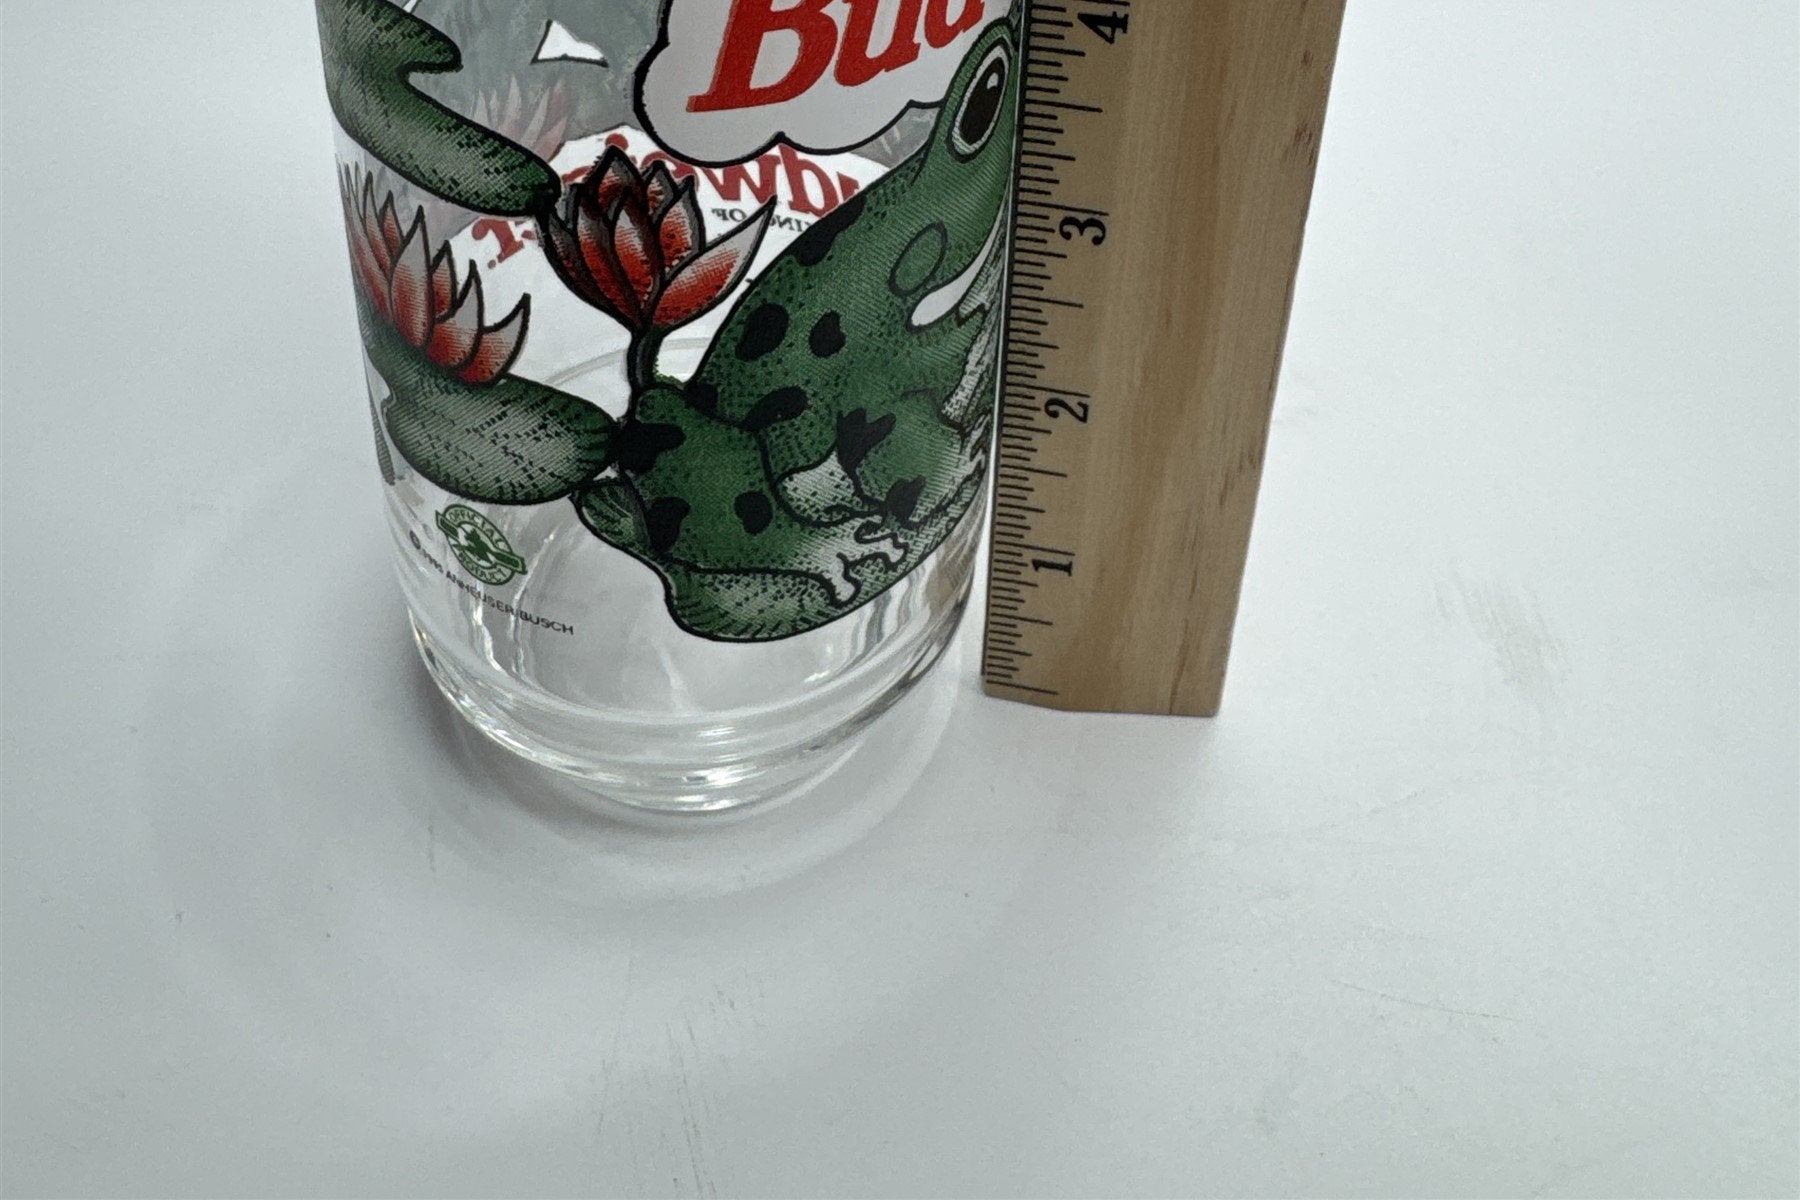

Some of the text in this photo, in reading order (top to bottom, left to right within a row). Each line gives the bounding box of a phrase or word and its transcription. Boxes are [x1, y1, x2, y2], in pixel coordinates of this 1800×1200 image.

[1077, 11, 1129, 45] 4
[1058, 215, 1106, 246] 3
[1044, 397, 1089, 424] 2
[1031, 557, 1074, 577] 1
